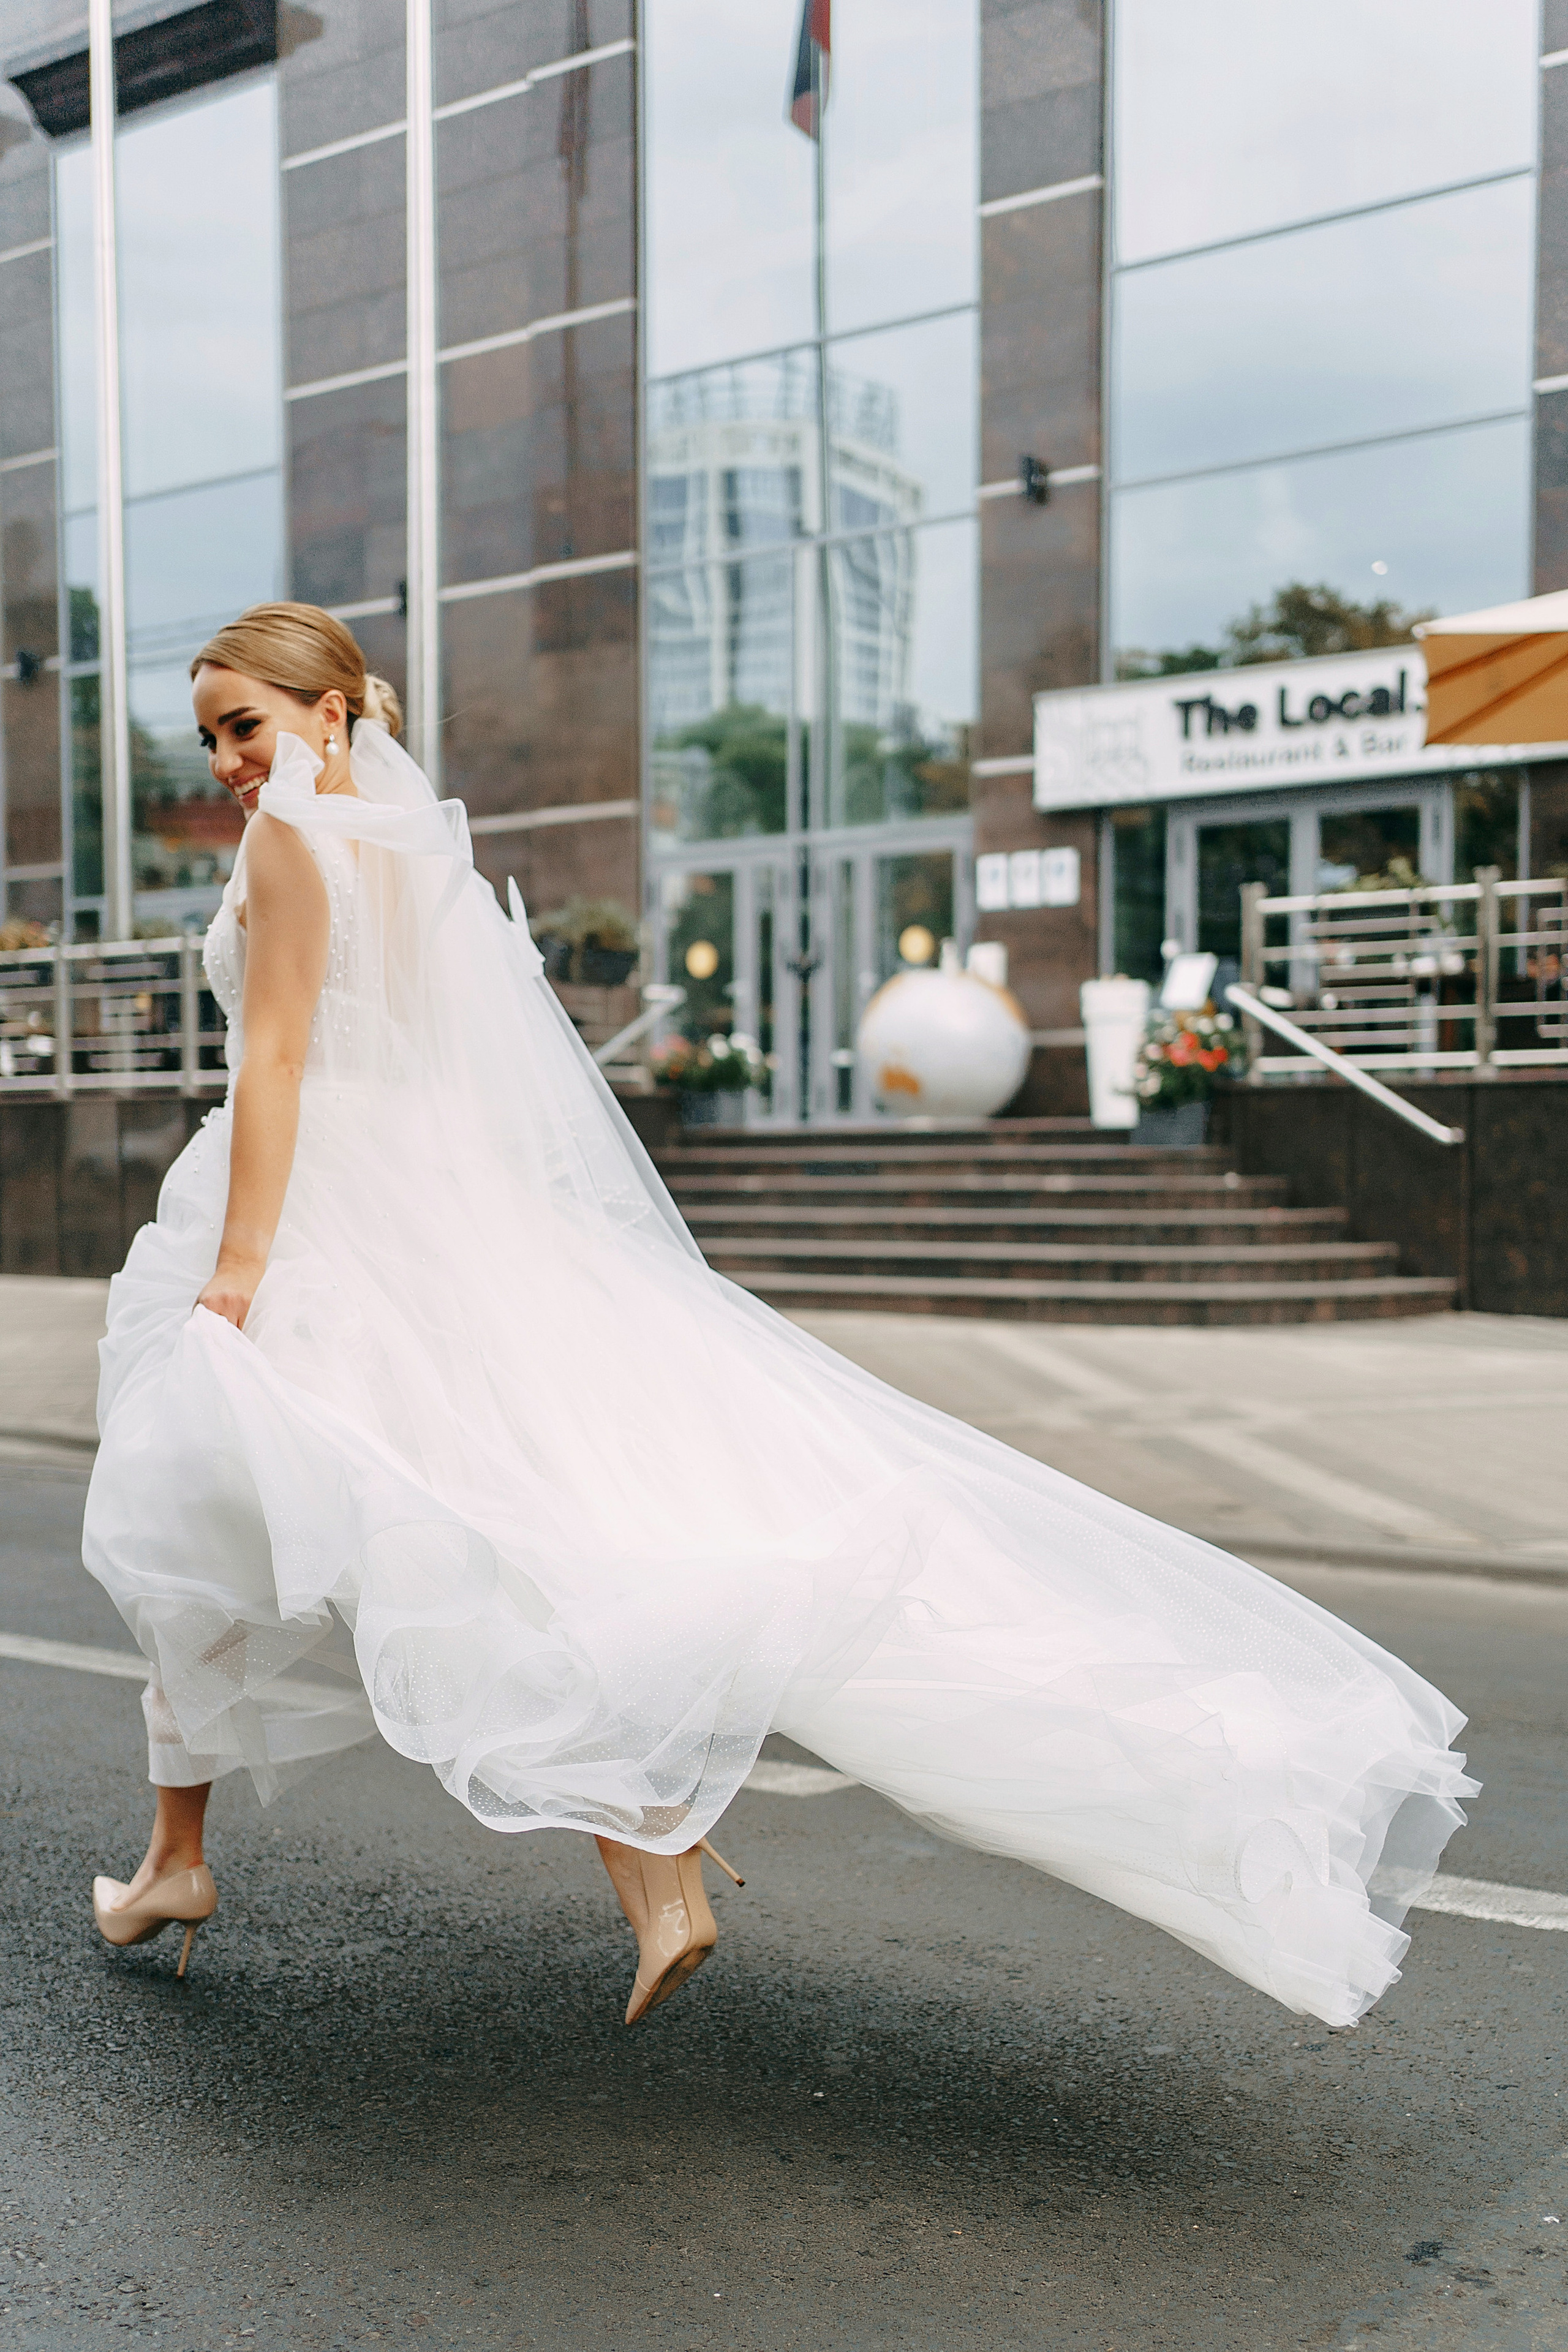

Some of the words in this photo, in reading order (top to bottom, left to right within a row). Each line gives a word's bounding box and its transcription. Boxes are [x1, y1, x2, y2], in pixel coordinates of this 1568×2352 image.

[1172, 692, 1259, 740] The
[1181, 741, 1321, 774] Restaurant
[1335, 736, 1349, 759] &
[1361, 731, 1407, 755] Bar
